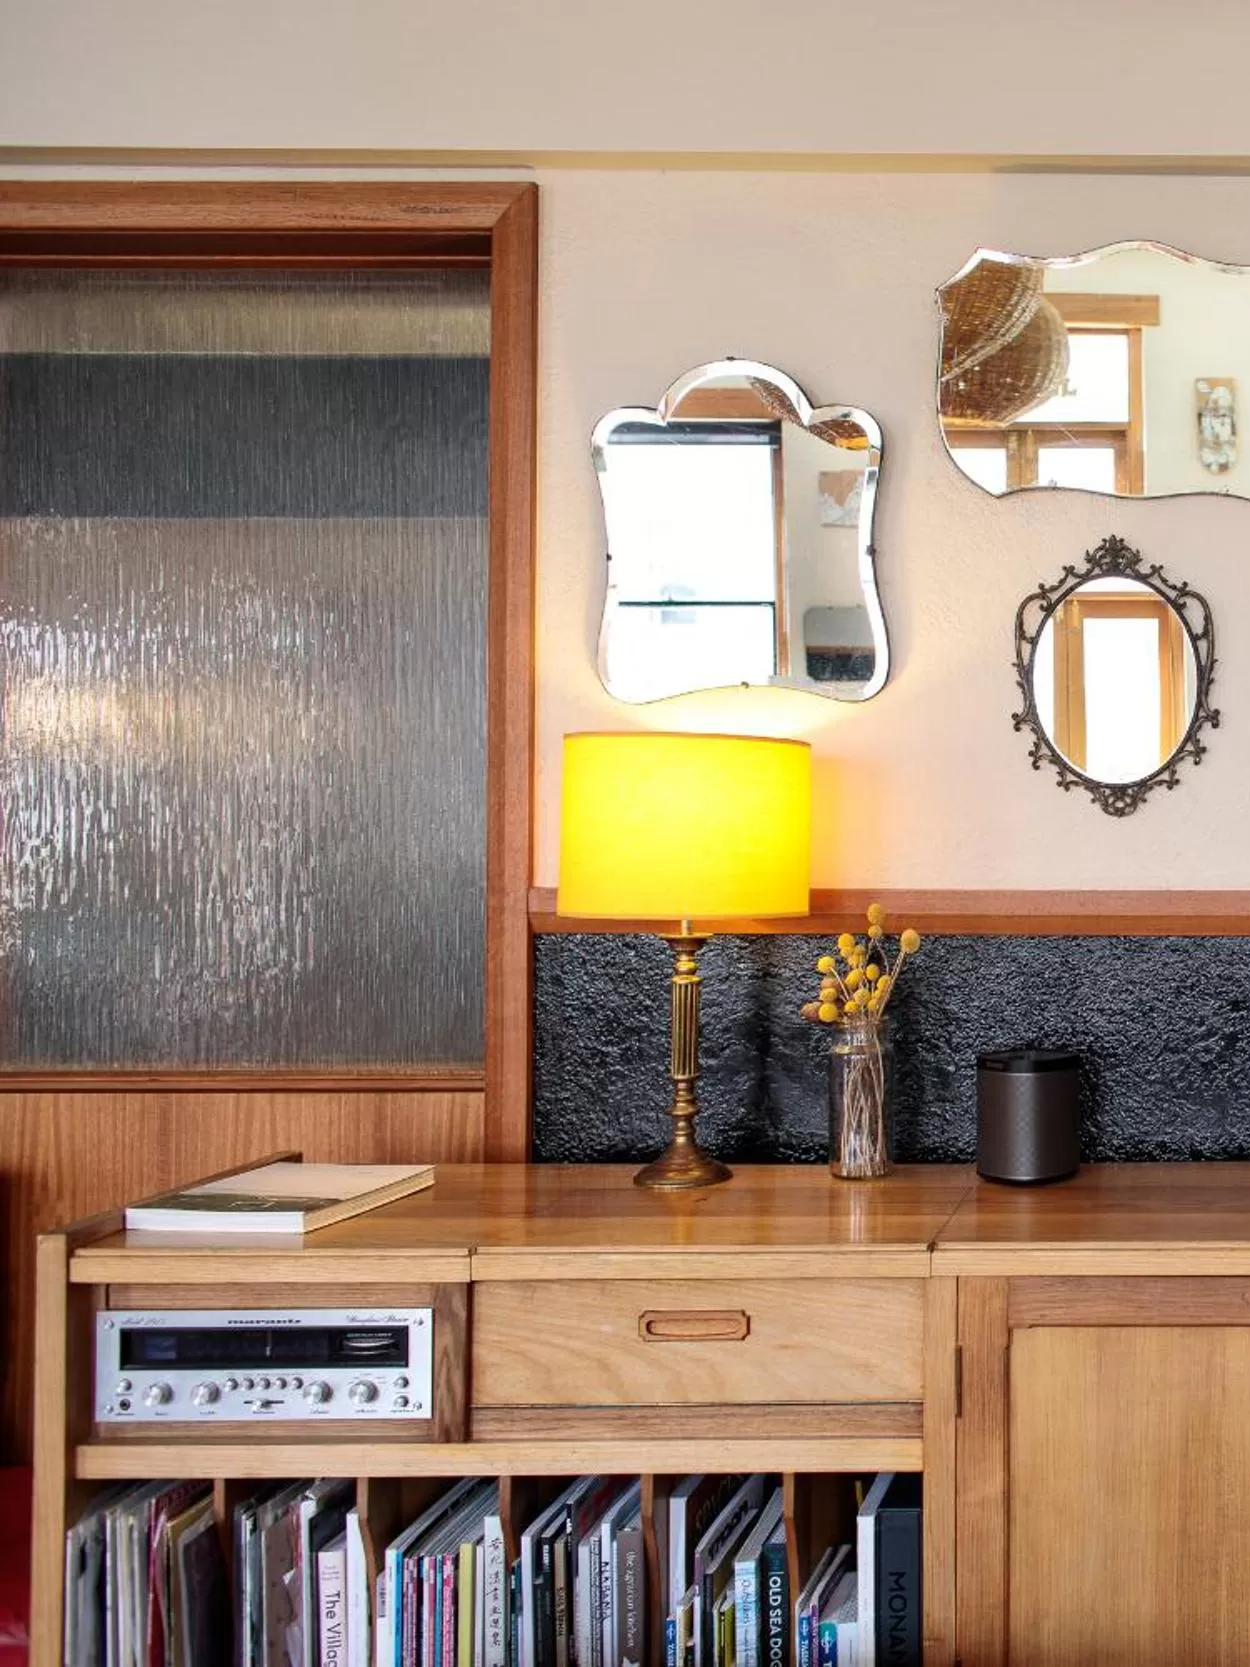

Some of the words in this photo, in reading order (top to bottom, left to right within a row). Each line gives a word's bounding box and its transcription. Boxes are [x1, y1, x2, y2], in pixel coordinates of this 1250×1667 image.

[769, 1576, 782, 1605] OLD
[325, 1591, 341, 1619] The
[769, 1608, 782, 1635] SEA
